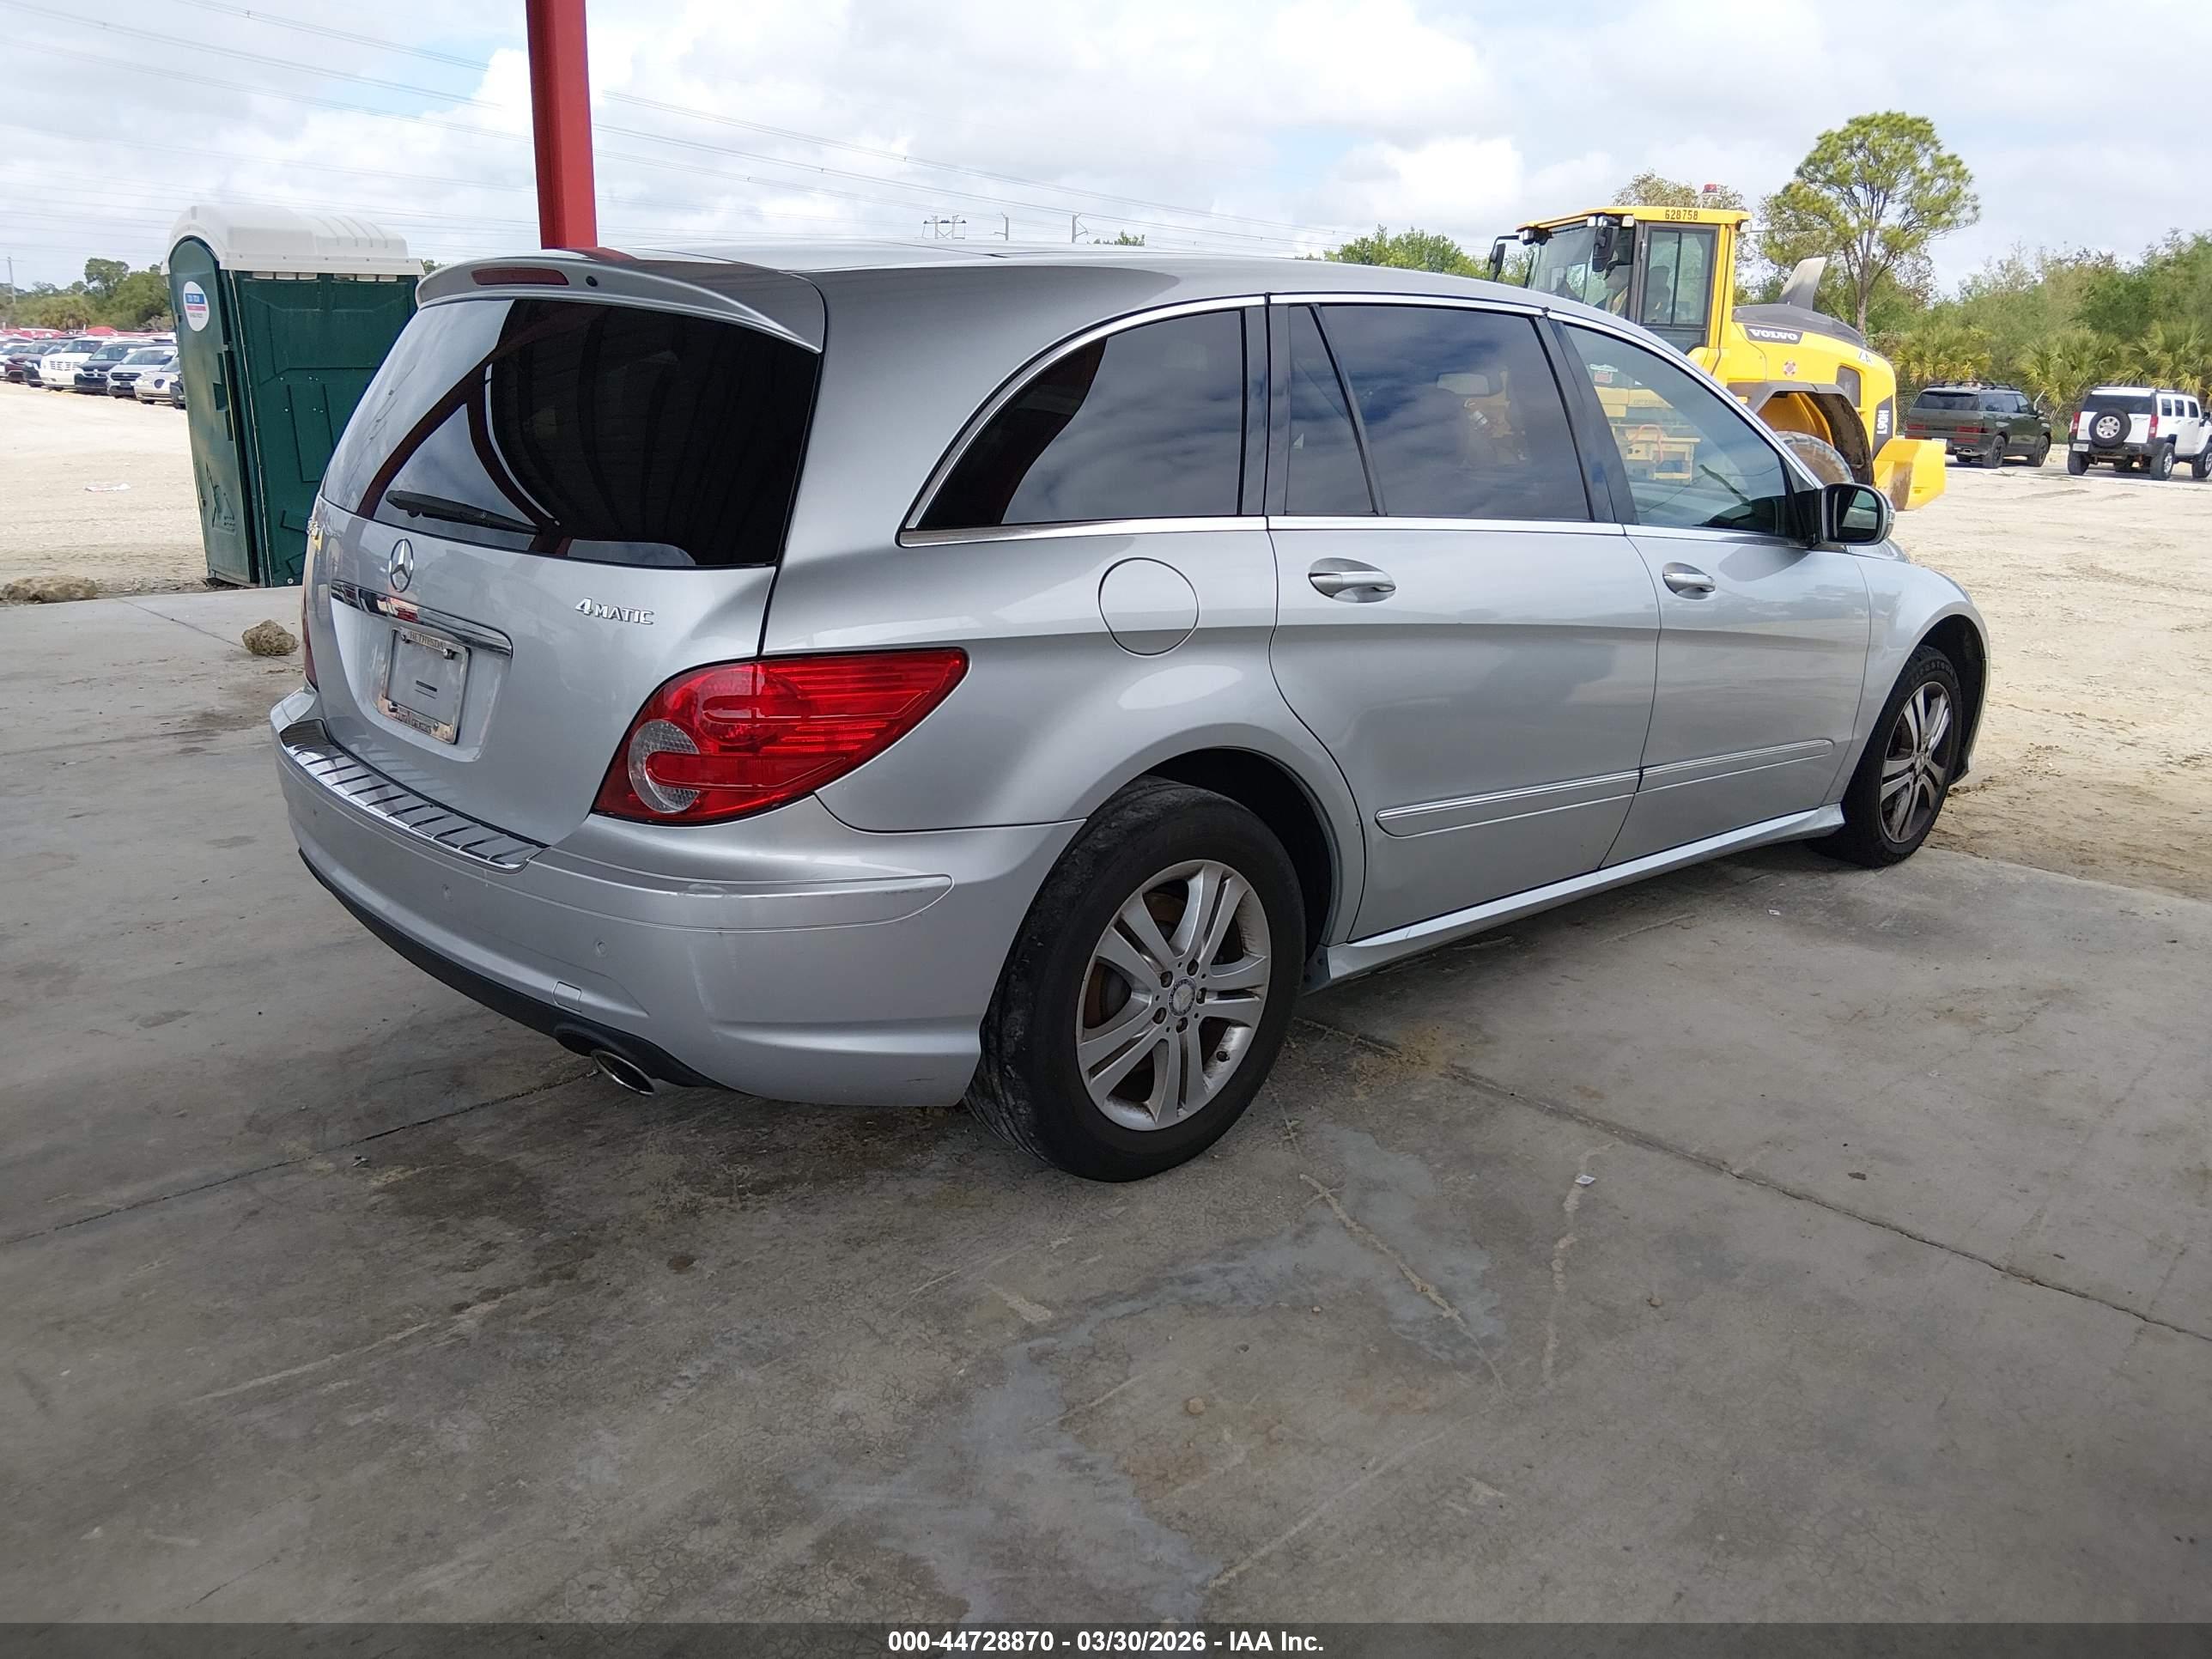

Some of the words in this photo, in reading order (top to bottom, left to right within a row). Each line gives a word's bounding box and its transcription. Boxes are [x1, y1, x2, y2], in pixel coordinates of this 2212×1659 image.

[1664, 209, 1699, 221] 628758
[1748, 328, 1798, 342] VOLVO
[1876, 410, 1890, 434] L90H
